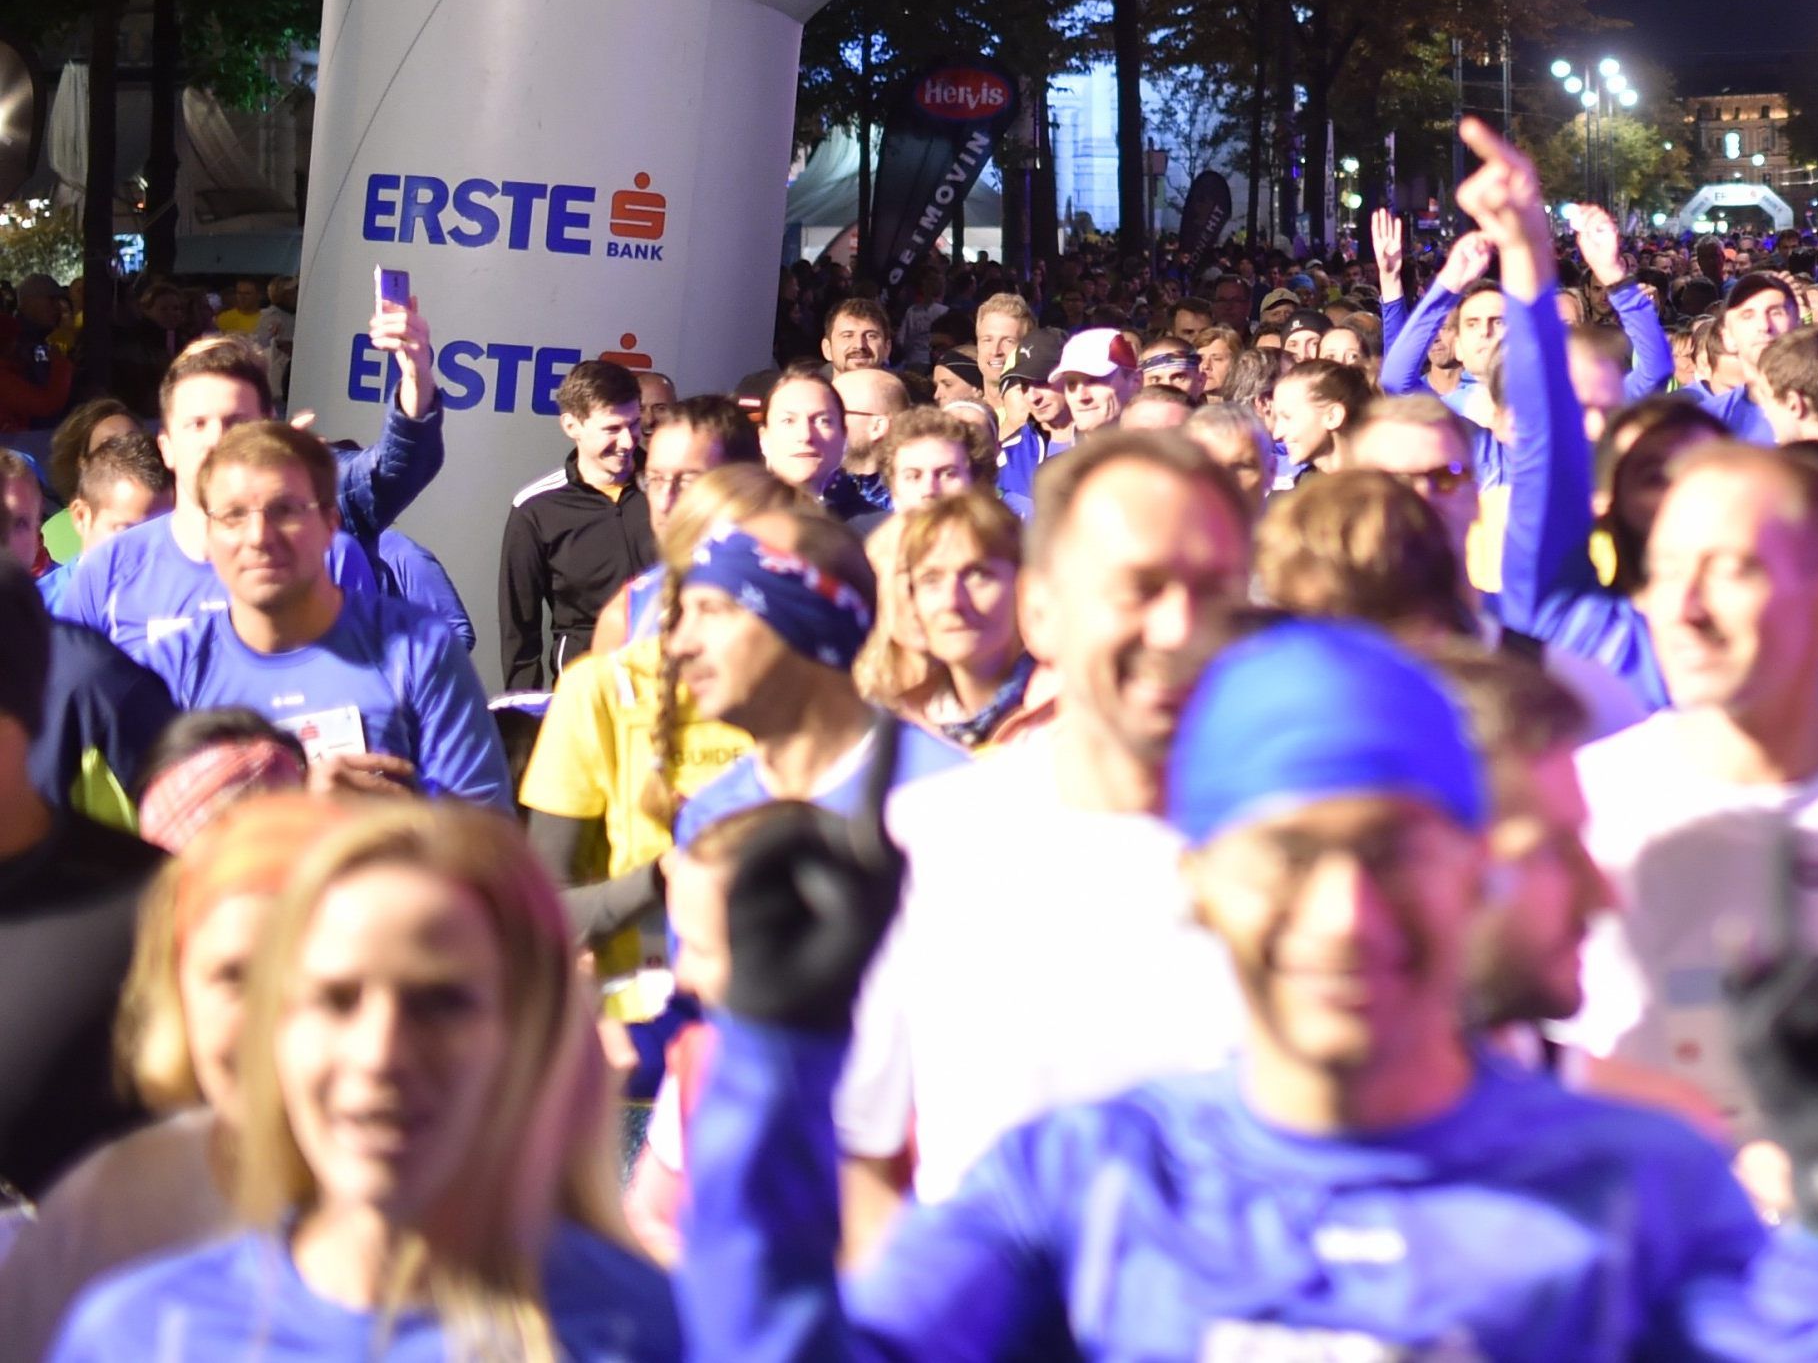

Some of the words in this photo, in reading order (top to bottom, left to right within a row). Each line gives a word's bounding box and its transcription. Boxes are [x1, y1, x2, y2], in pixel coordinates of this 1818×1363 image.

[924, 78, 1004, 111] Hervis
[362, 174, 596, 255] ERSTE
[607, 242, 663, 261] BANK
